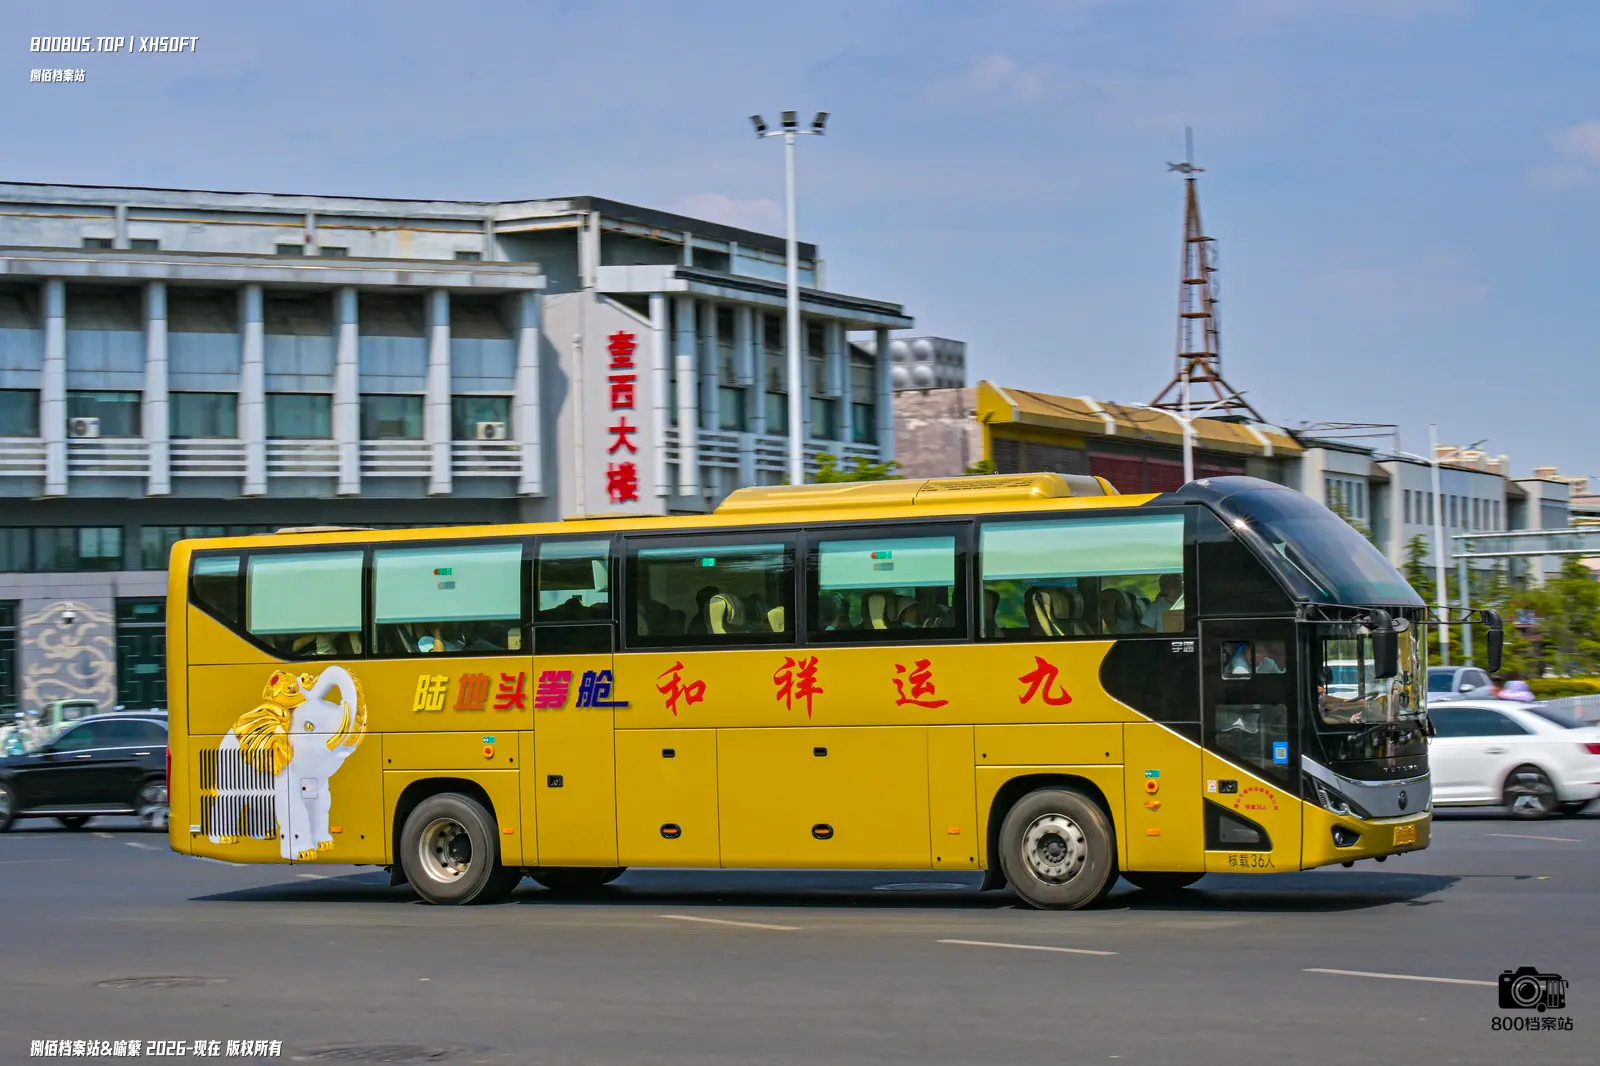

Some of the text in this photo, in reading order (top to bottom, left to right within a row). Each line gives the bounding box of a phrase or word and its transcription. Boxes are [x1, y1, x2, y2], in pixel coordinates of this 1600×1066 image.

[412, 669, 630, 712] 陆地头等舱
[1228, 853, 1275, 869] 核载36人
